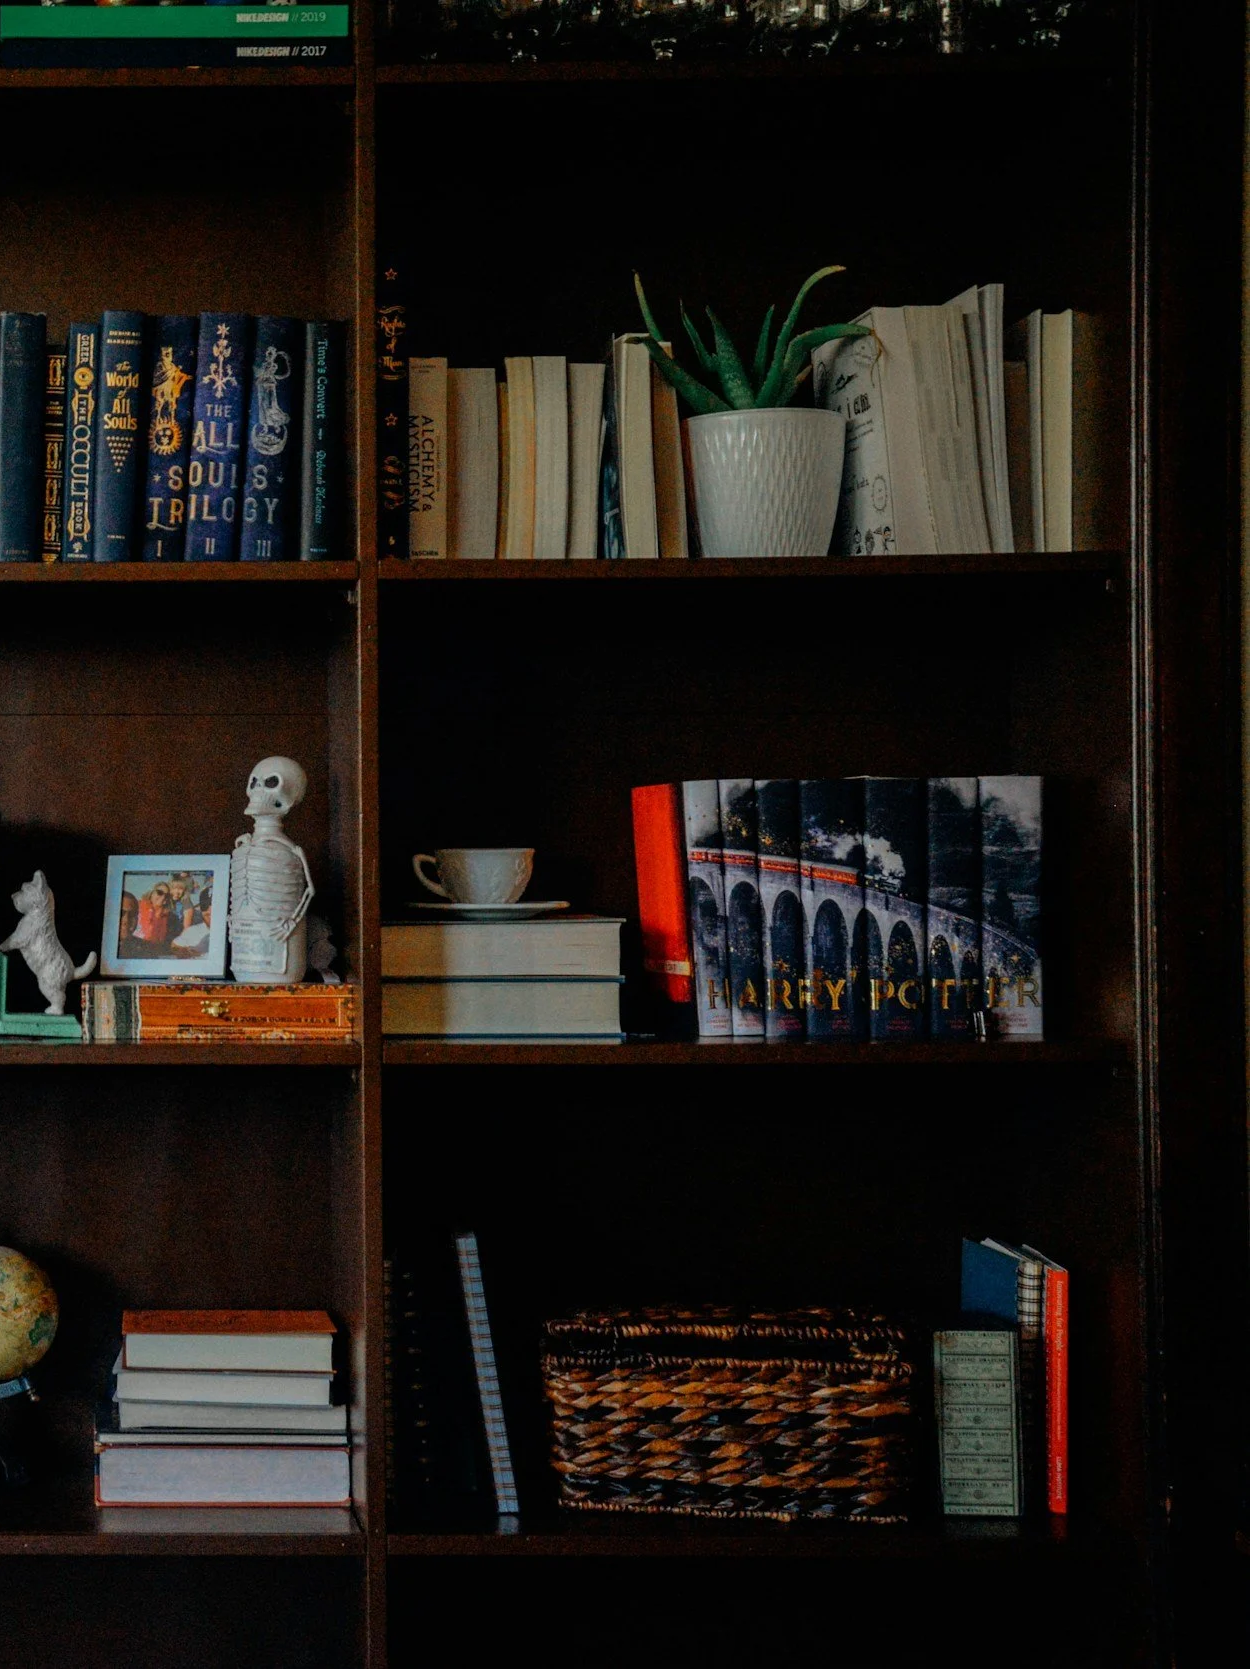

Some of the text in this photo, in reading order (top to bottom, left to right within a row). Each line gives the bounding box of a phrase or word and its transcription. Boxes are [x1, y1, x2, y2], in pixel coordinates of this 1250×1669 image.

[300, 11, 326, 22] 2019
[300, 46, 327, 56] 2017
[105, 371, 140, 389] World
[315, 340, 329, 420] Time's Convert
[112, 398, 132, 414] All
[205, 404, 233, 418] THE
[102, 412, 138, 430] Souls
[70, 334, 92, 531] GREER THE OCCULT BOOK
[191, 420, 241, 454] ALL
[421, 415, 436, 513] ALCHEMY &
[168, 461, 269, 491] SOULS
[146, 494, 281, 531] TRILOGY
[205, 538, 216, 556] II
[256, 540, 272, 558] III
[706, 978, 844, 1013] HARRY
